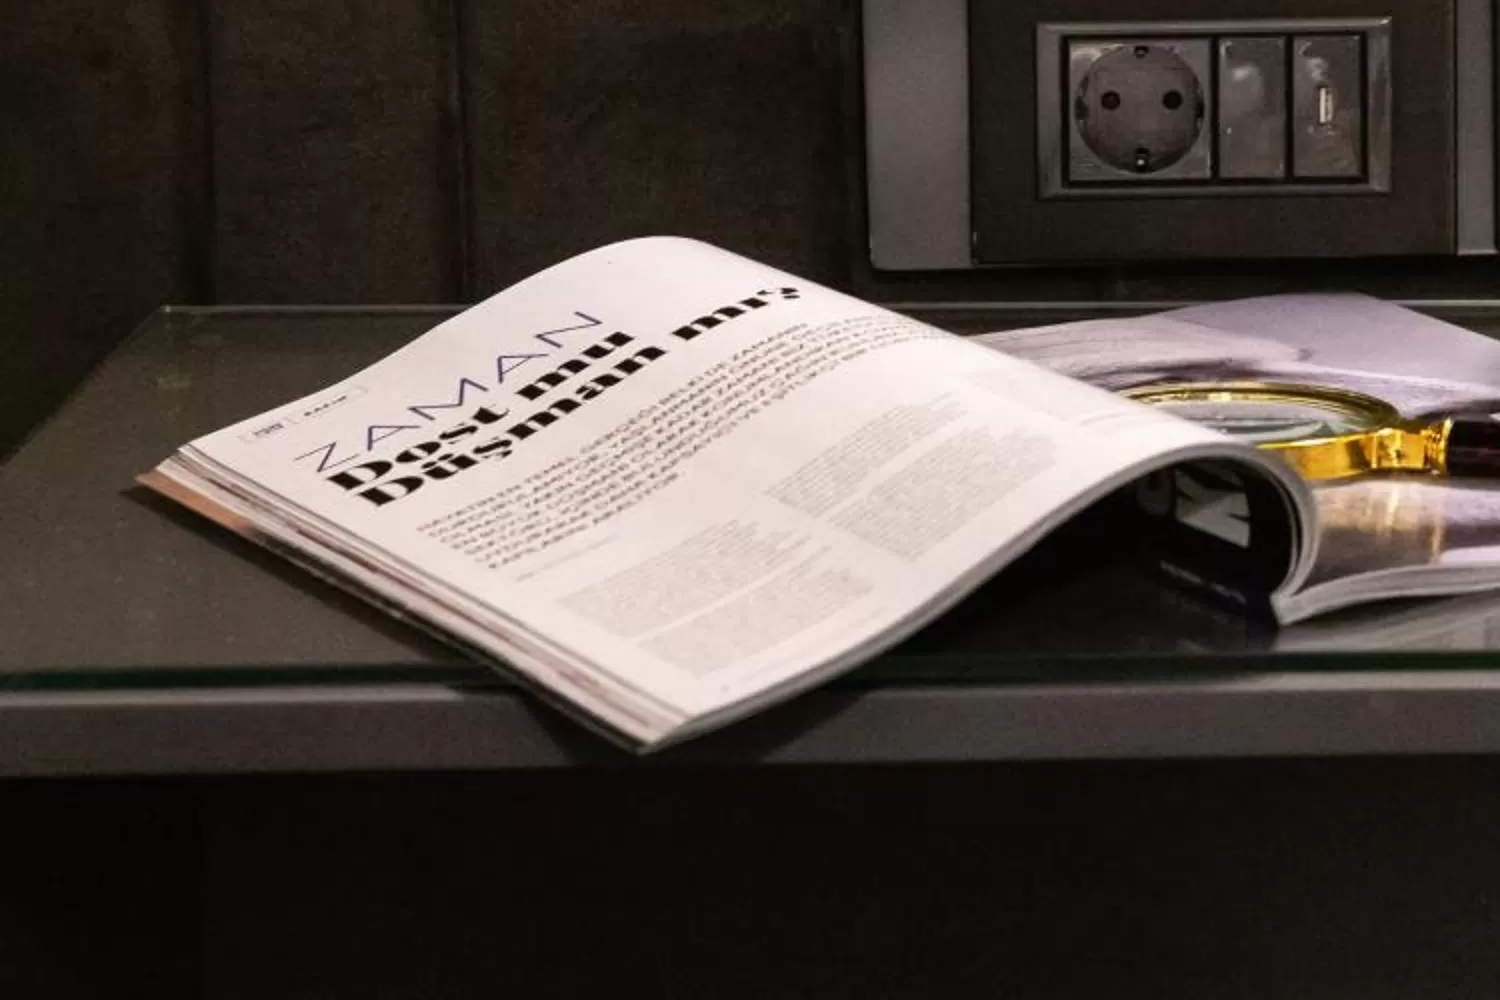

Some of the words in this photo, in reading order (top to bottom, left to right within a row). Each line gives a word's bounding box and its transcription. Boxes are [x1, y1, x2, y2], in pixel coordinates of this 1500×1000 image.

[295, 311, 604, 473] ZAMAN
[326, 404, 511, 491] Dost
[515, 331, 636, 401] mu
[357, 345, 667, 507] Düşman
